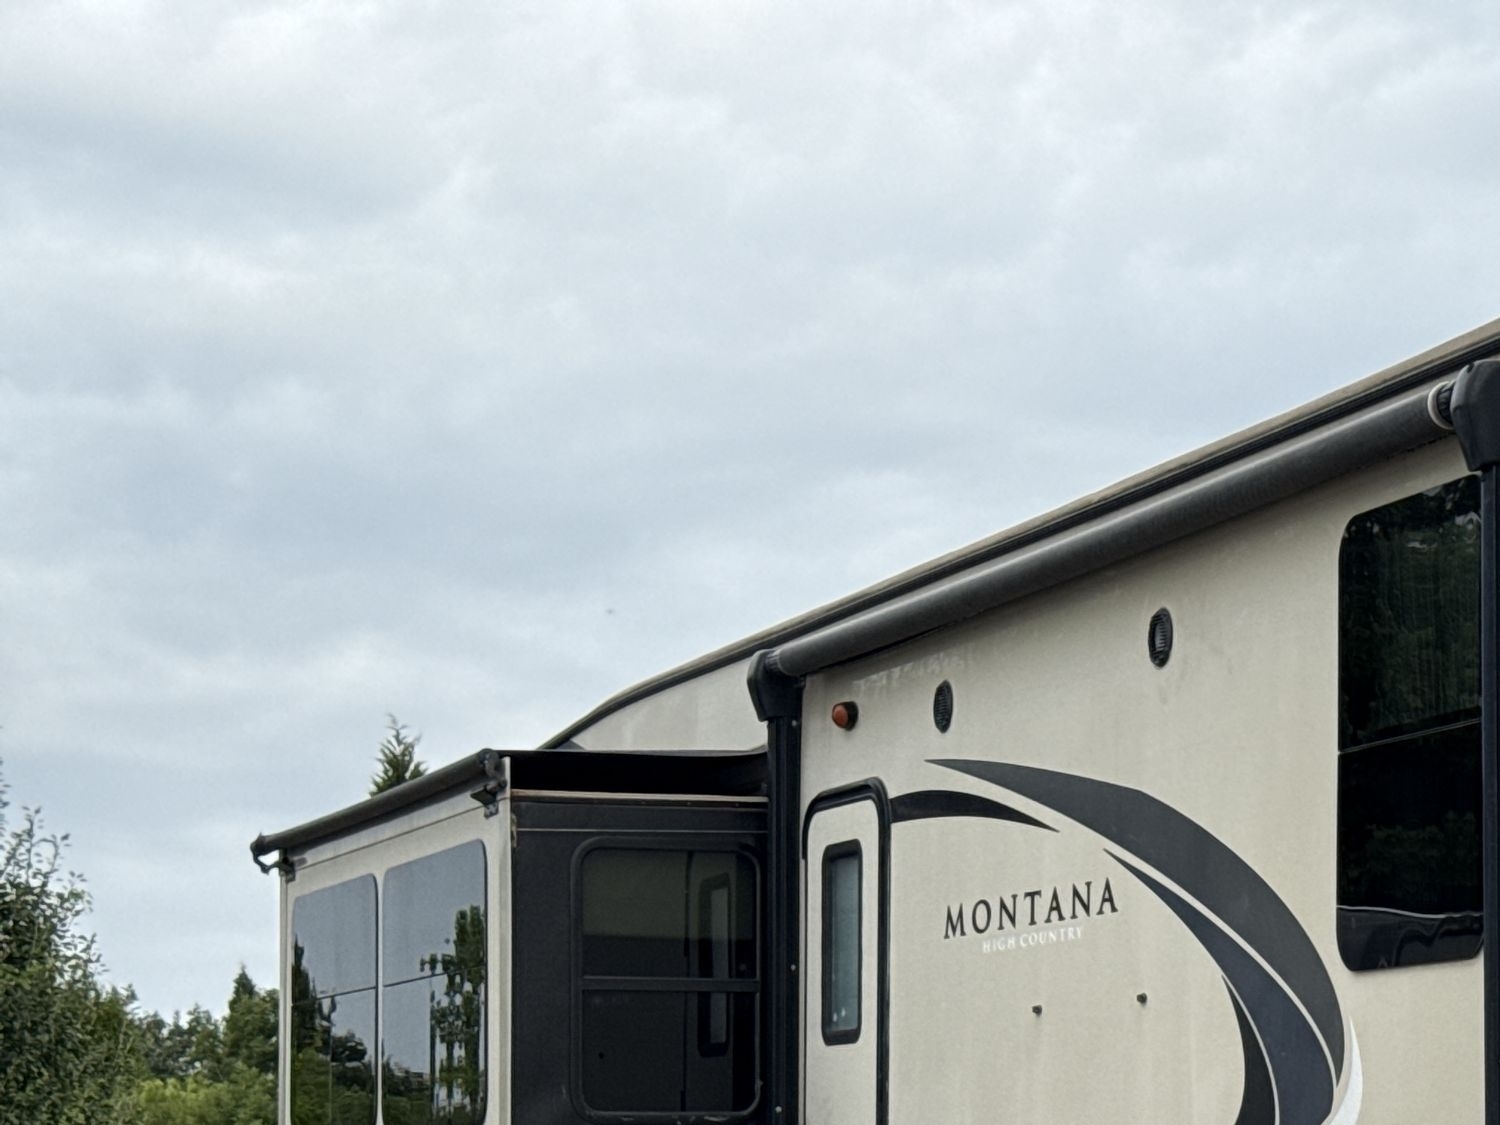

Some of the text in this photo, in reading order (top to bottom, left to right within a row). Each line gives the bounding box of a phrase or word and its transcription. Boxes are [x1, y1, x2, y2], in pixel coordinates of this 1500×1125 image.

[944, 877, 1118, 939] MONTANA
[982, 927, 1082, 953] HIGH COUNTRY
